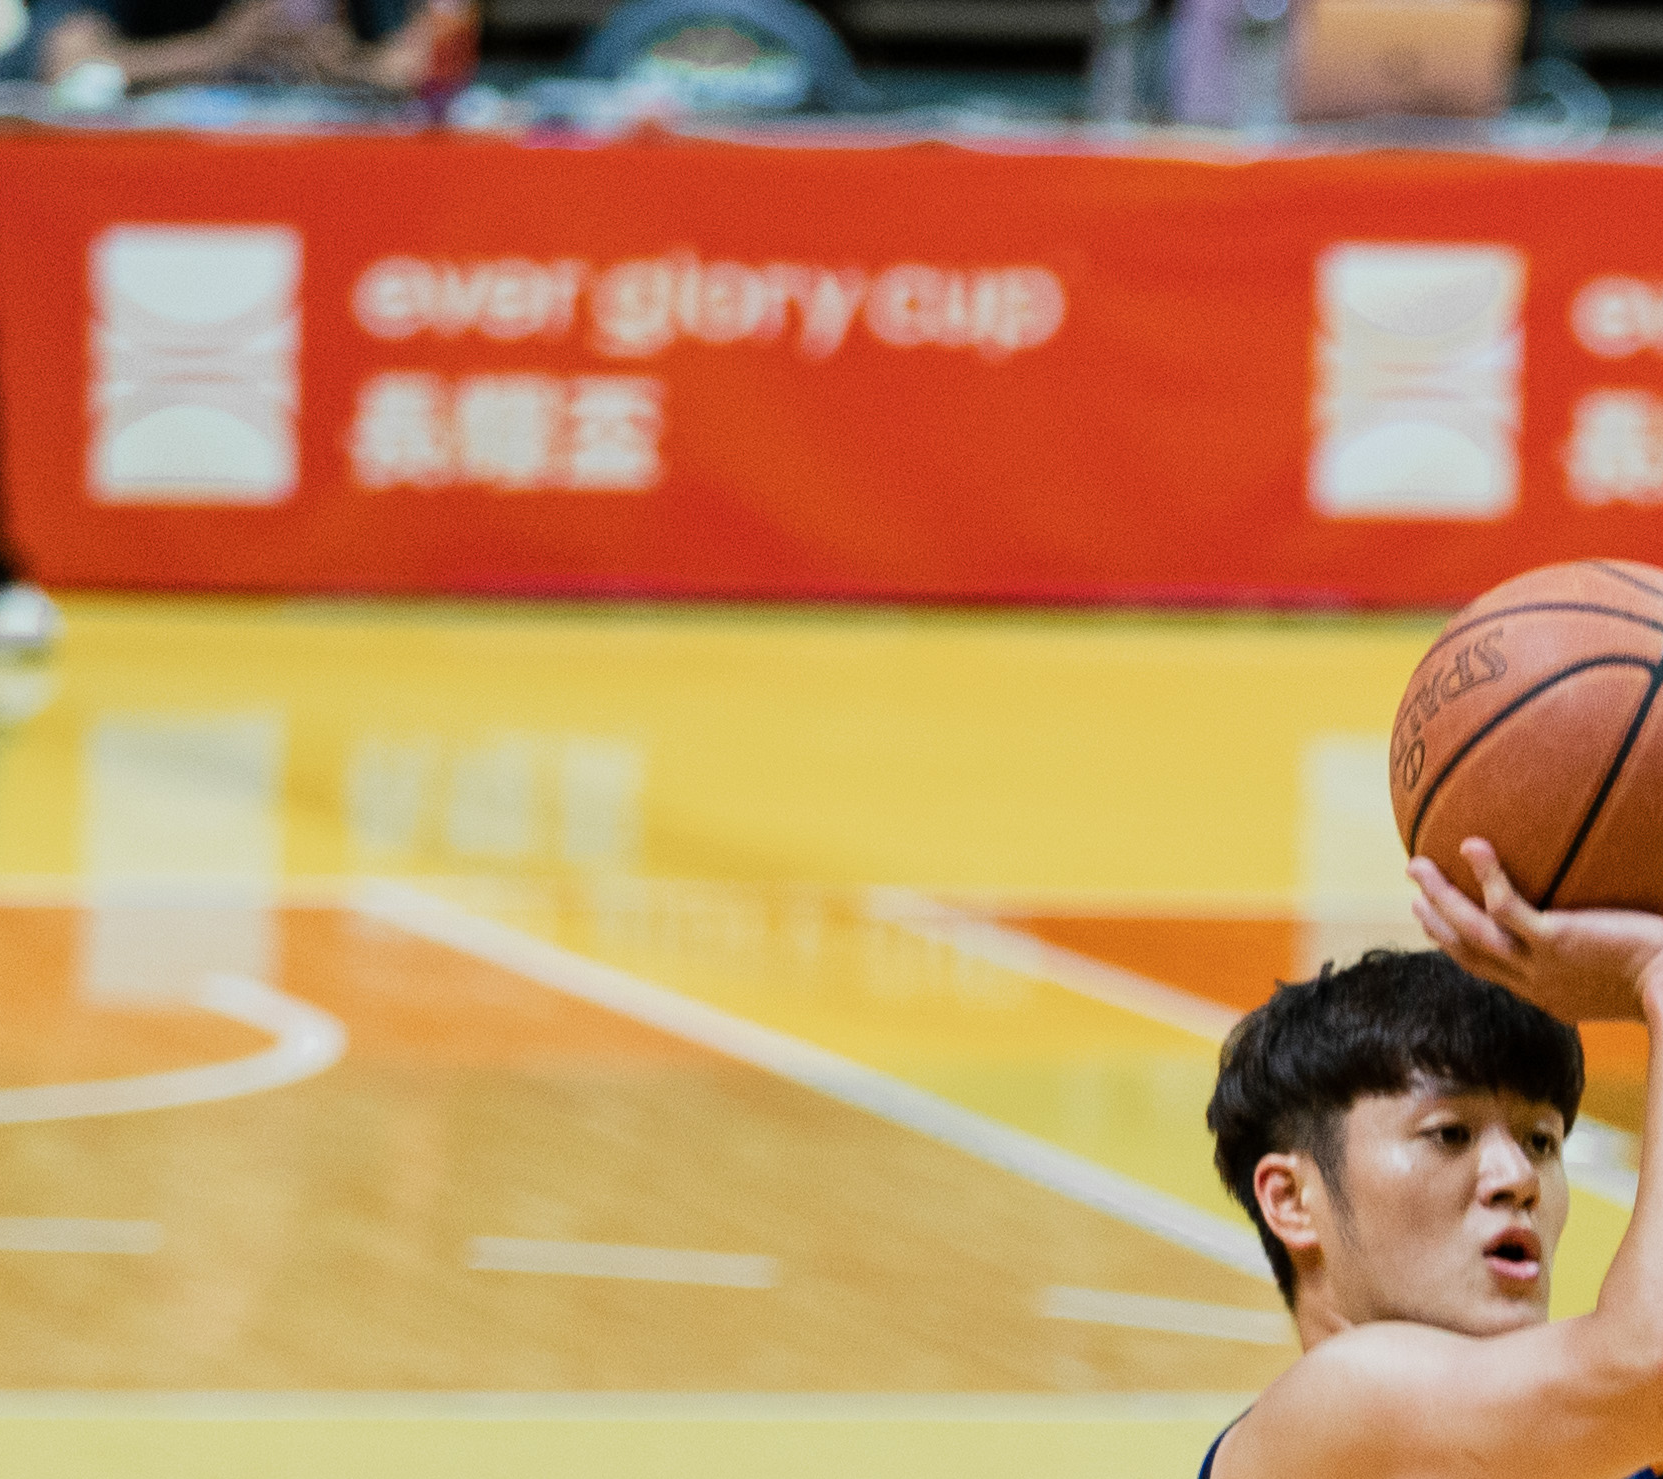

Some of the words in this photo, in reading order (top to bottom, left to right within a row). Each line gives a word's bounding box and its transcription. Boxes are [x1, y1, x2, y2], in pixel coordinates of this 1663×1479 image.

[349, 251, 581, 338] ever
[591, 243, 863, 356] glory
[865, 258, 1067, 358] cup
